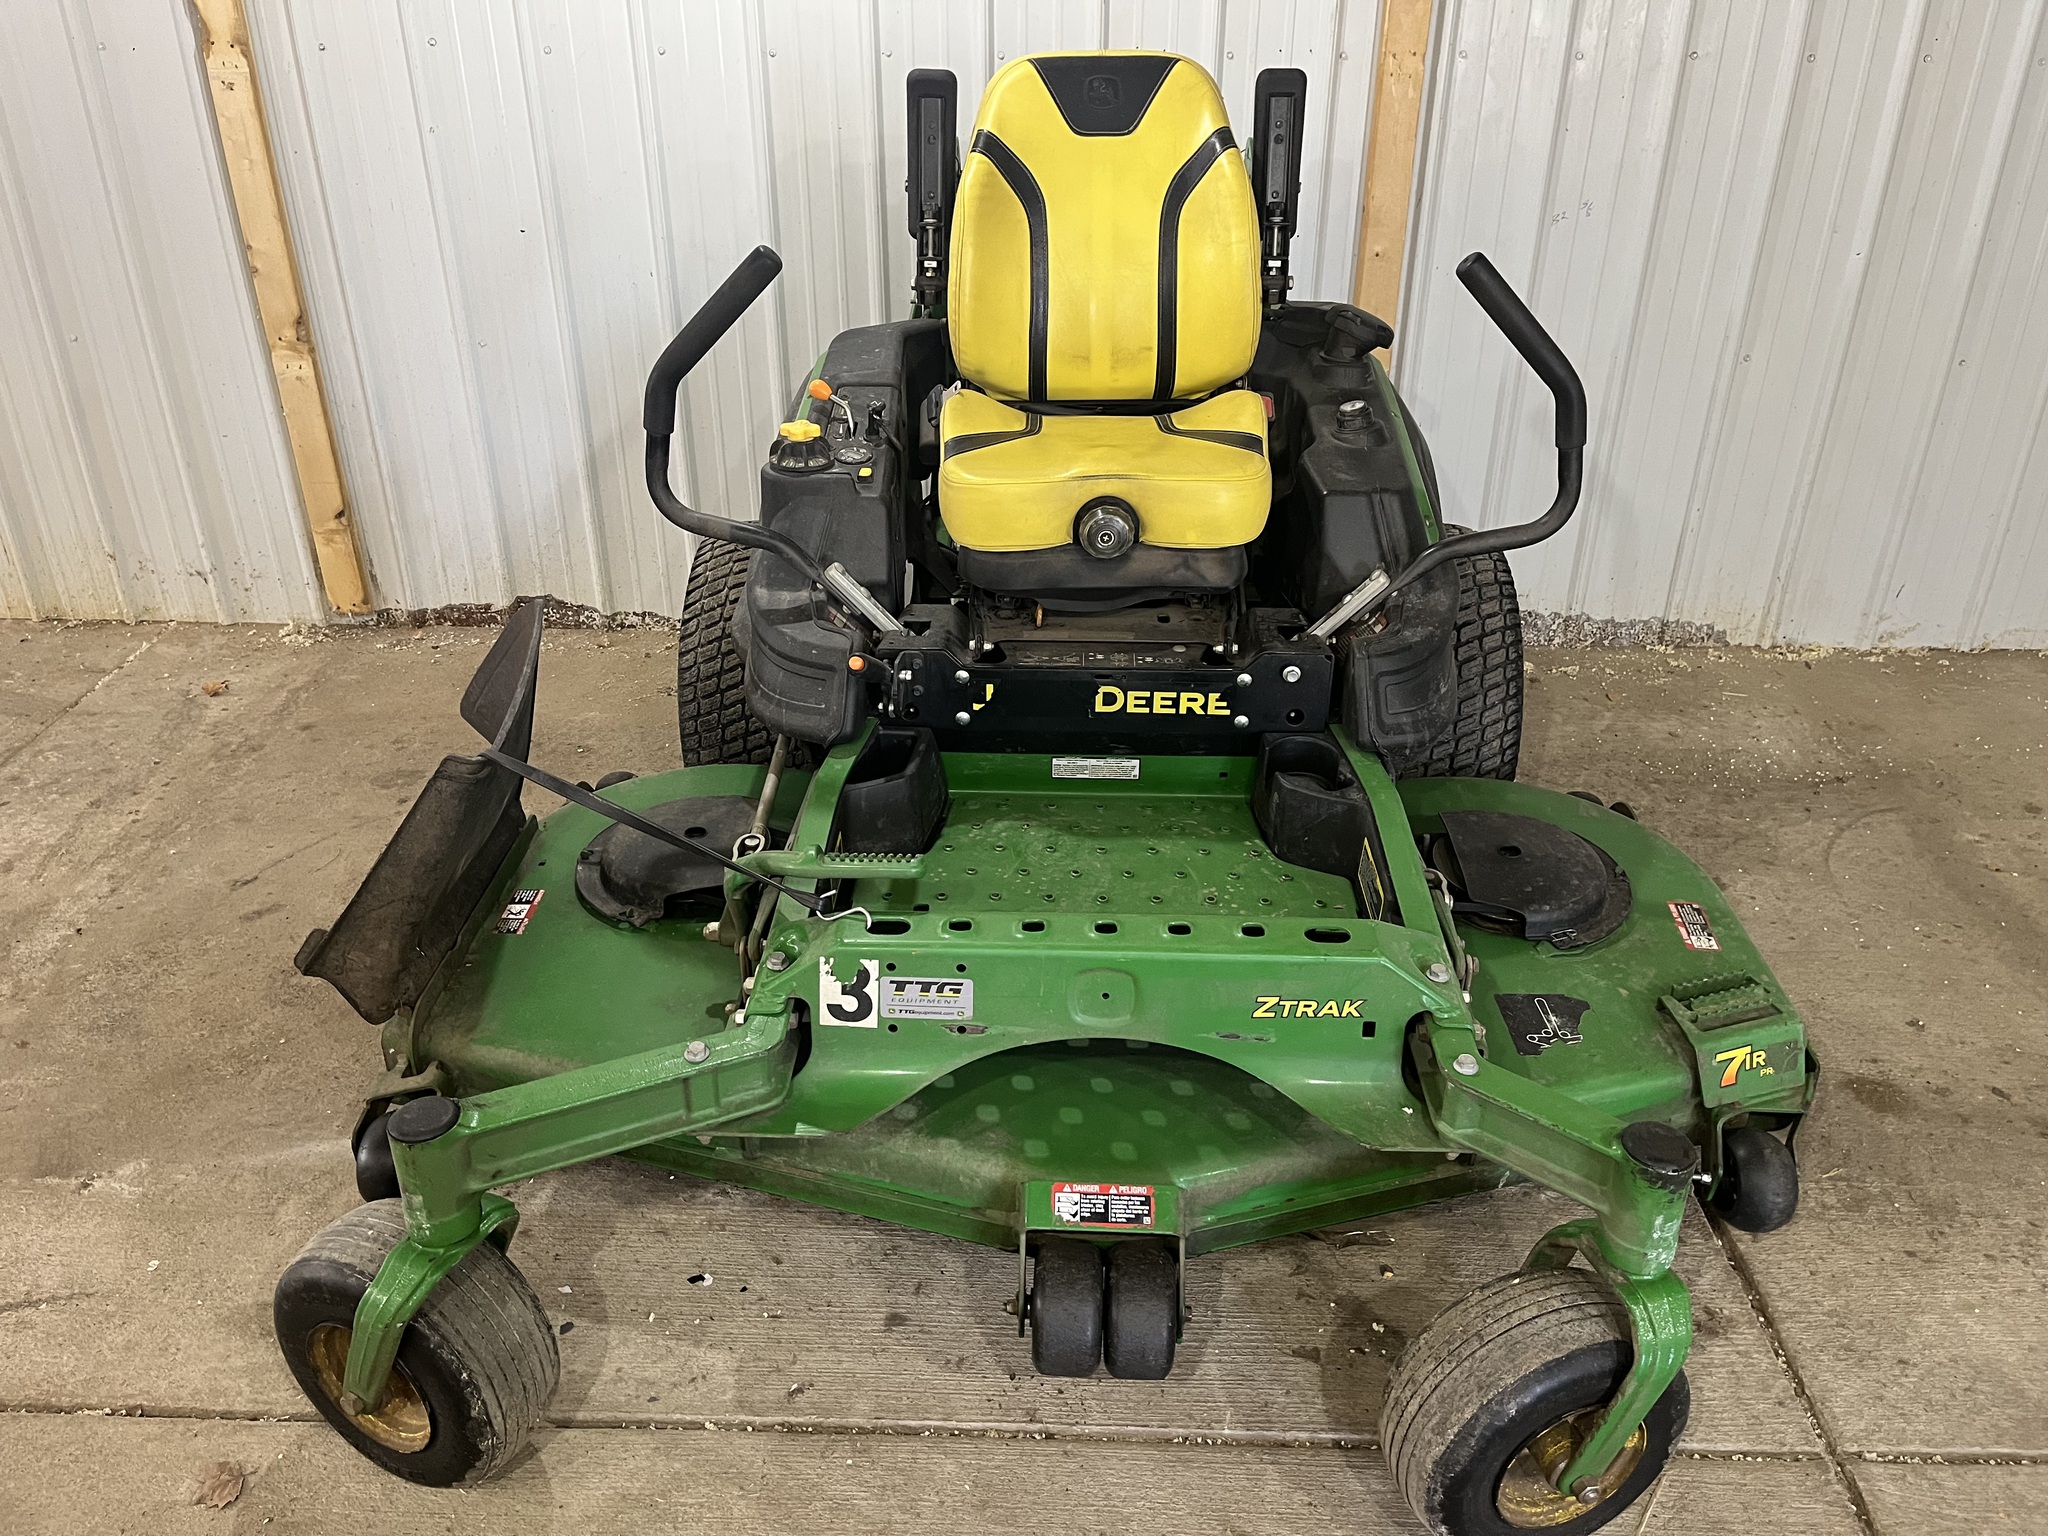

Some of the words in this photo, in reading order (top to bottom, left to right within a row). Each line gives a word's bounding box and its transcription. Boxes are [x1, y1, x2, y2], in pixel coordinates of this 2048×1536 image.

[1094, 685, 1231, 715] DEERE
[889, 980, 964, 998] TTG
[1251, 995, 1367, 1018] ZTRAK
[1760, 1066, 1775, 1077] PR
[1072, 1184, 1100, 1192] DANGER
[1119, 1186, 1147, 1194] PELIGRO
